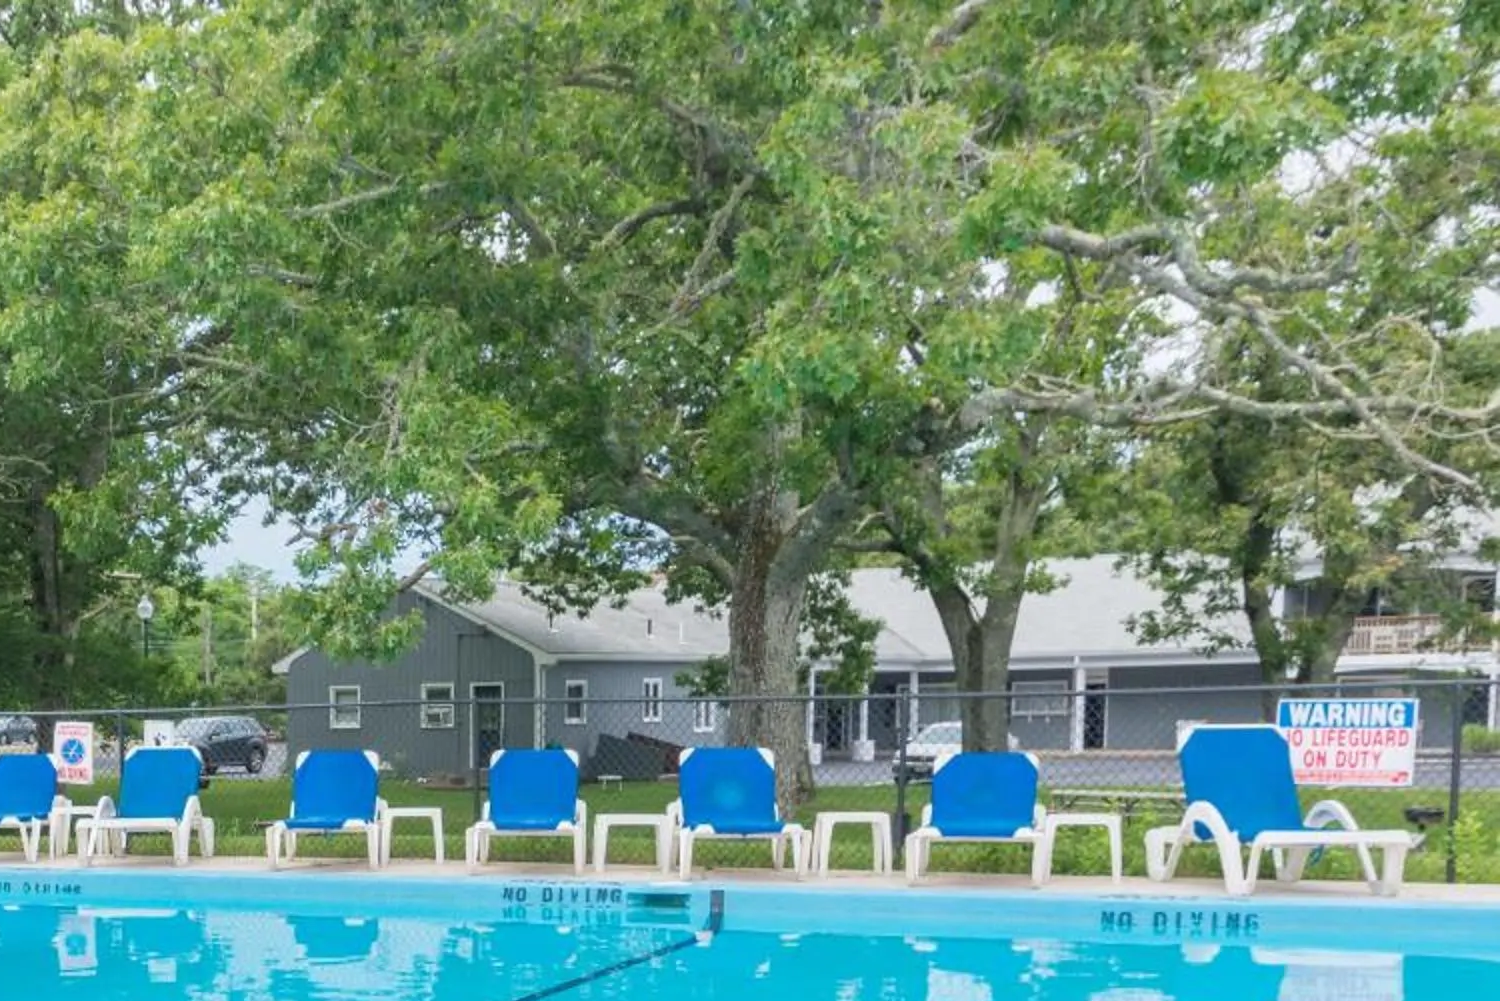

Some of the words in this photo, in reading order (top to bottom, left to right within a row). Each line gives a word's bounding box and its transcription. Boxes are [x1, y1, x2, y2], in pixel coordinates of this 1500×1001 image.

[1289, 702, 1407, 727] WARNING
[1311, 729, 1410, 747] LIFEGUARD
[1303, 748, 1327, 768] ON
[1335, 751, 1382, 768] DUTY
[502, 886, 527, 902] NO
[541, 887, 622, 903] DIVING
[1100, 911, 1132, 928] NO
[1153, 911, 1260, 930] DIVING
